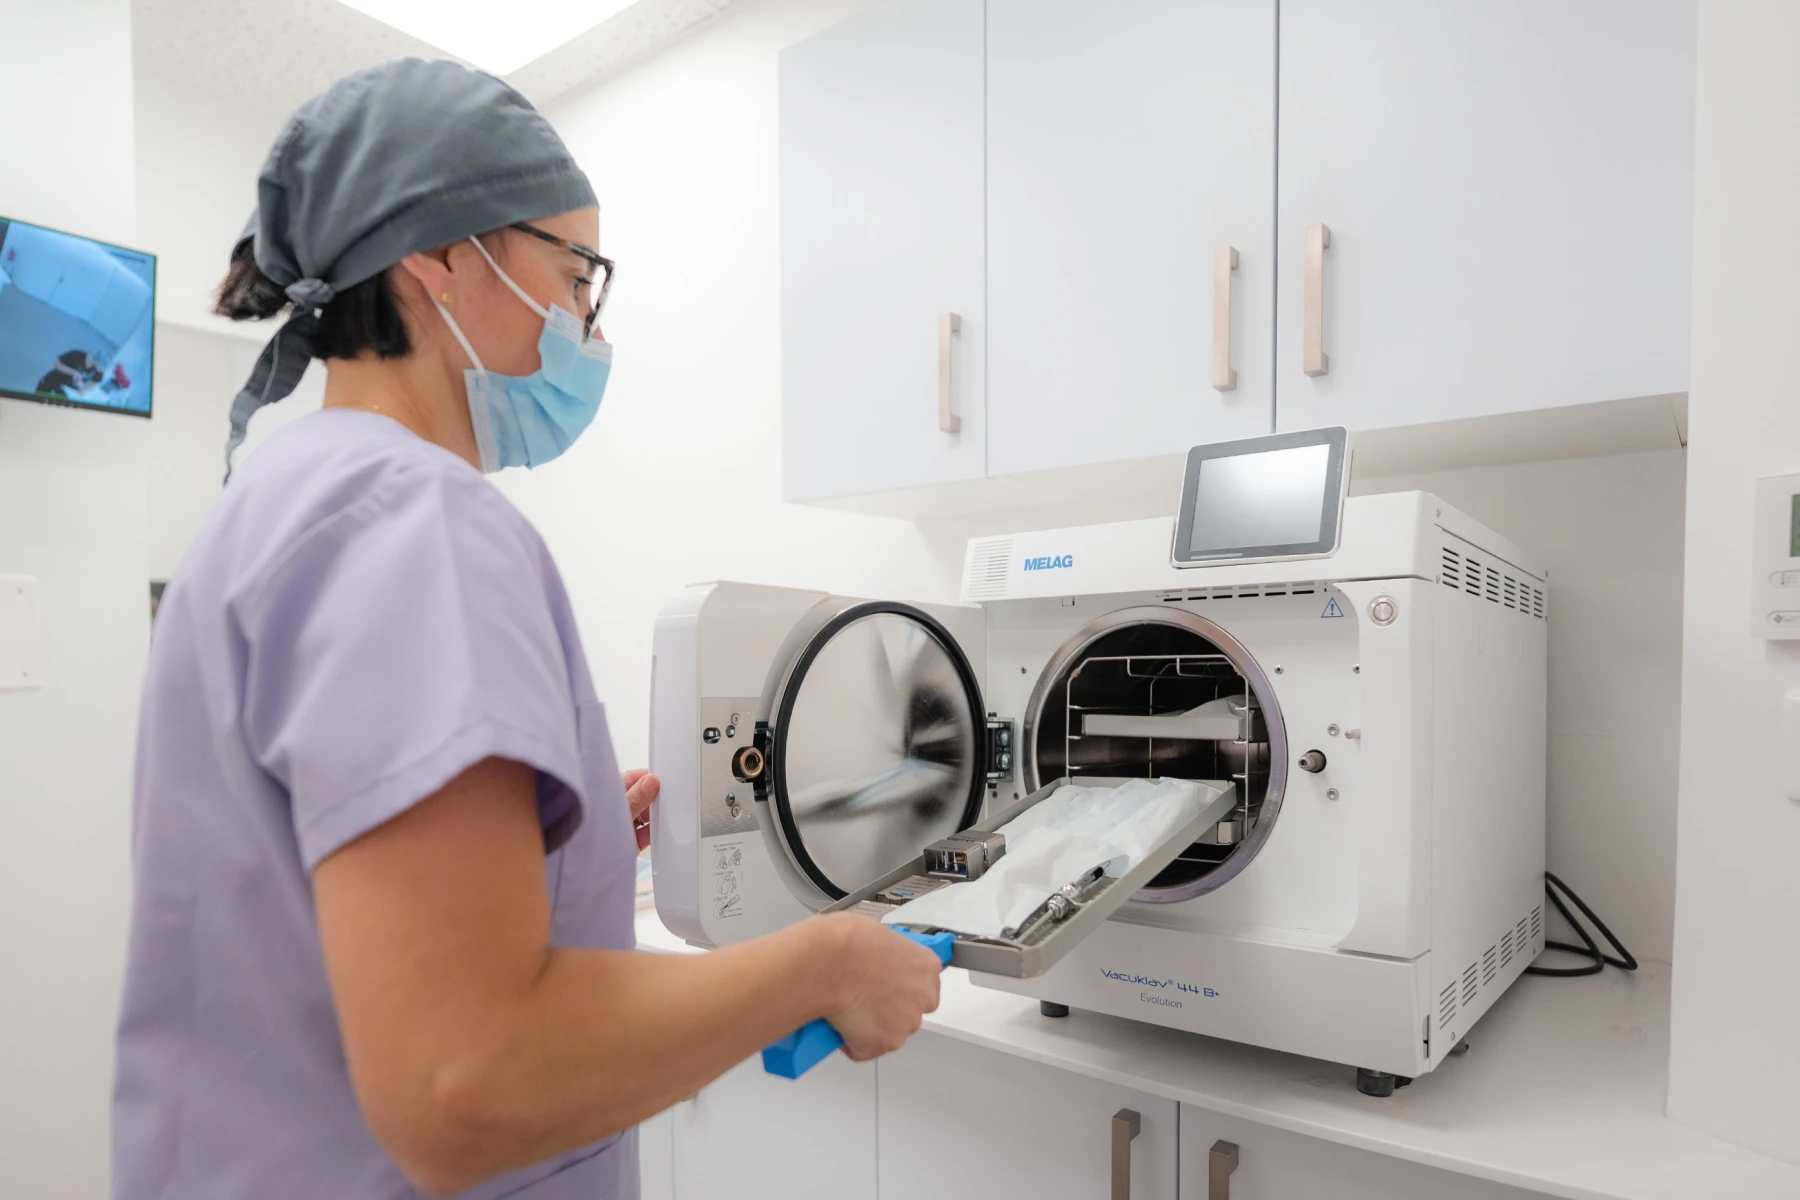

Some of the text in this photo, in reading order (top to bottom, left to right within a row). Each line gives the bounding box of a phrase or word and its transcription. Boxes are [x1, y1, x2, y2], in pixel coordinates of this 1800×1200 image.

[1023, 554, 1073, 571] MELAG
[1176, 982, 1200, 995] 44
[1203, 987, 1220, 998] B+
[1139, 992, 1183, 1009] Evolution
